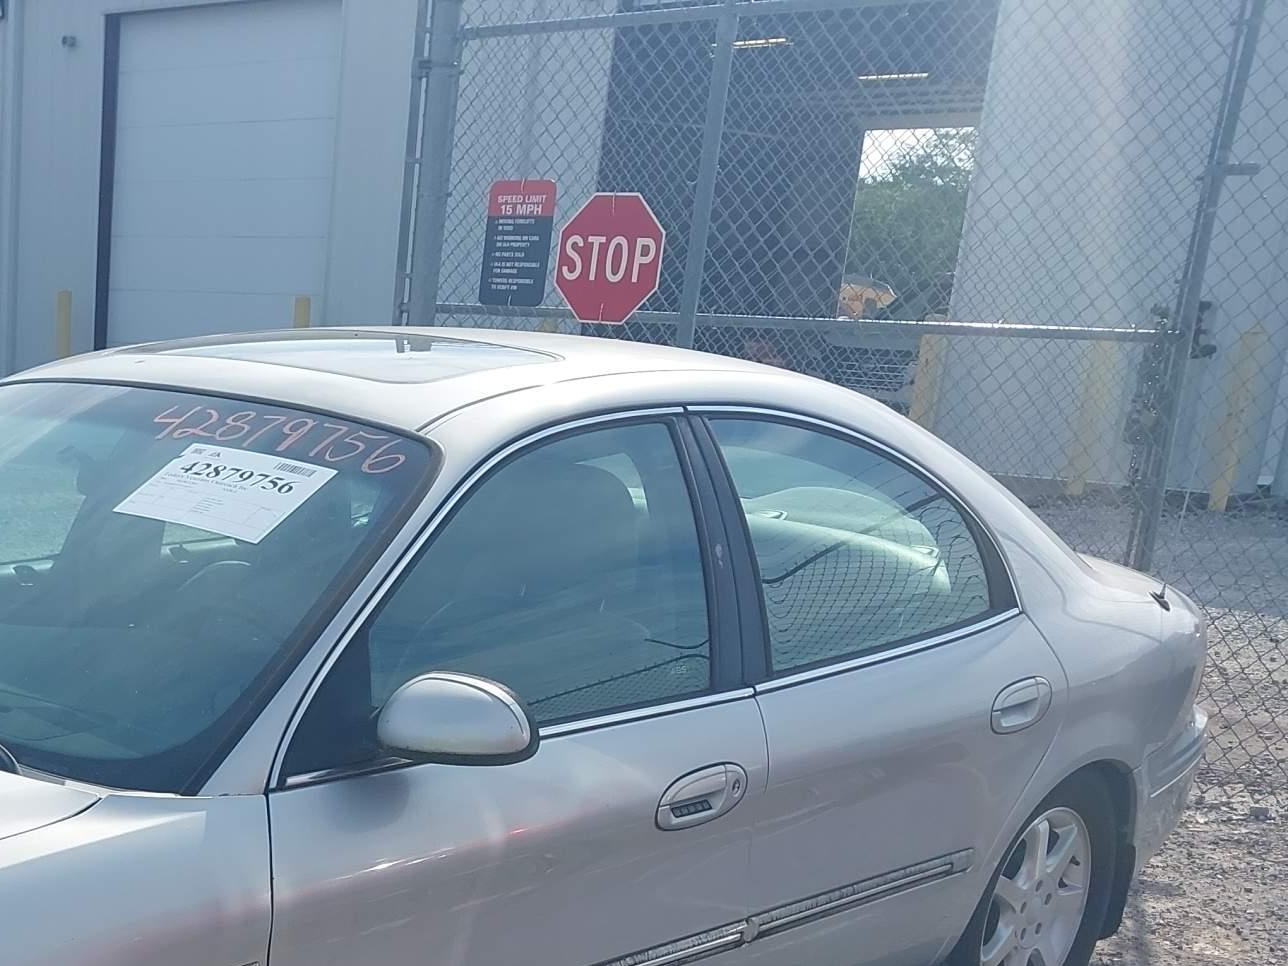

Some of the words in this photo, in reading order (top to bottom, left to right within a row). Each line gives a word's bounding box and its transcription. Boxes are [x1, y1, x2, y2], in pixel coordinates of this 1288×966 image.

[497, 195, 523, 203] SPEED
[525, 195, 546, 203] LIMIT
[500, 205, 513, 215] 15
[515, 204, 543, 216] MPH
[562, 235, 656, 283] STOP
[153, 405, 406, 473] 42879756
[180, 461, 302, 494] 42879756
